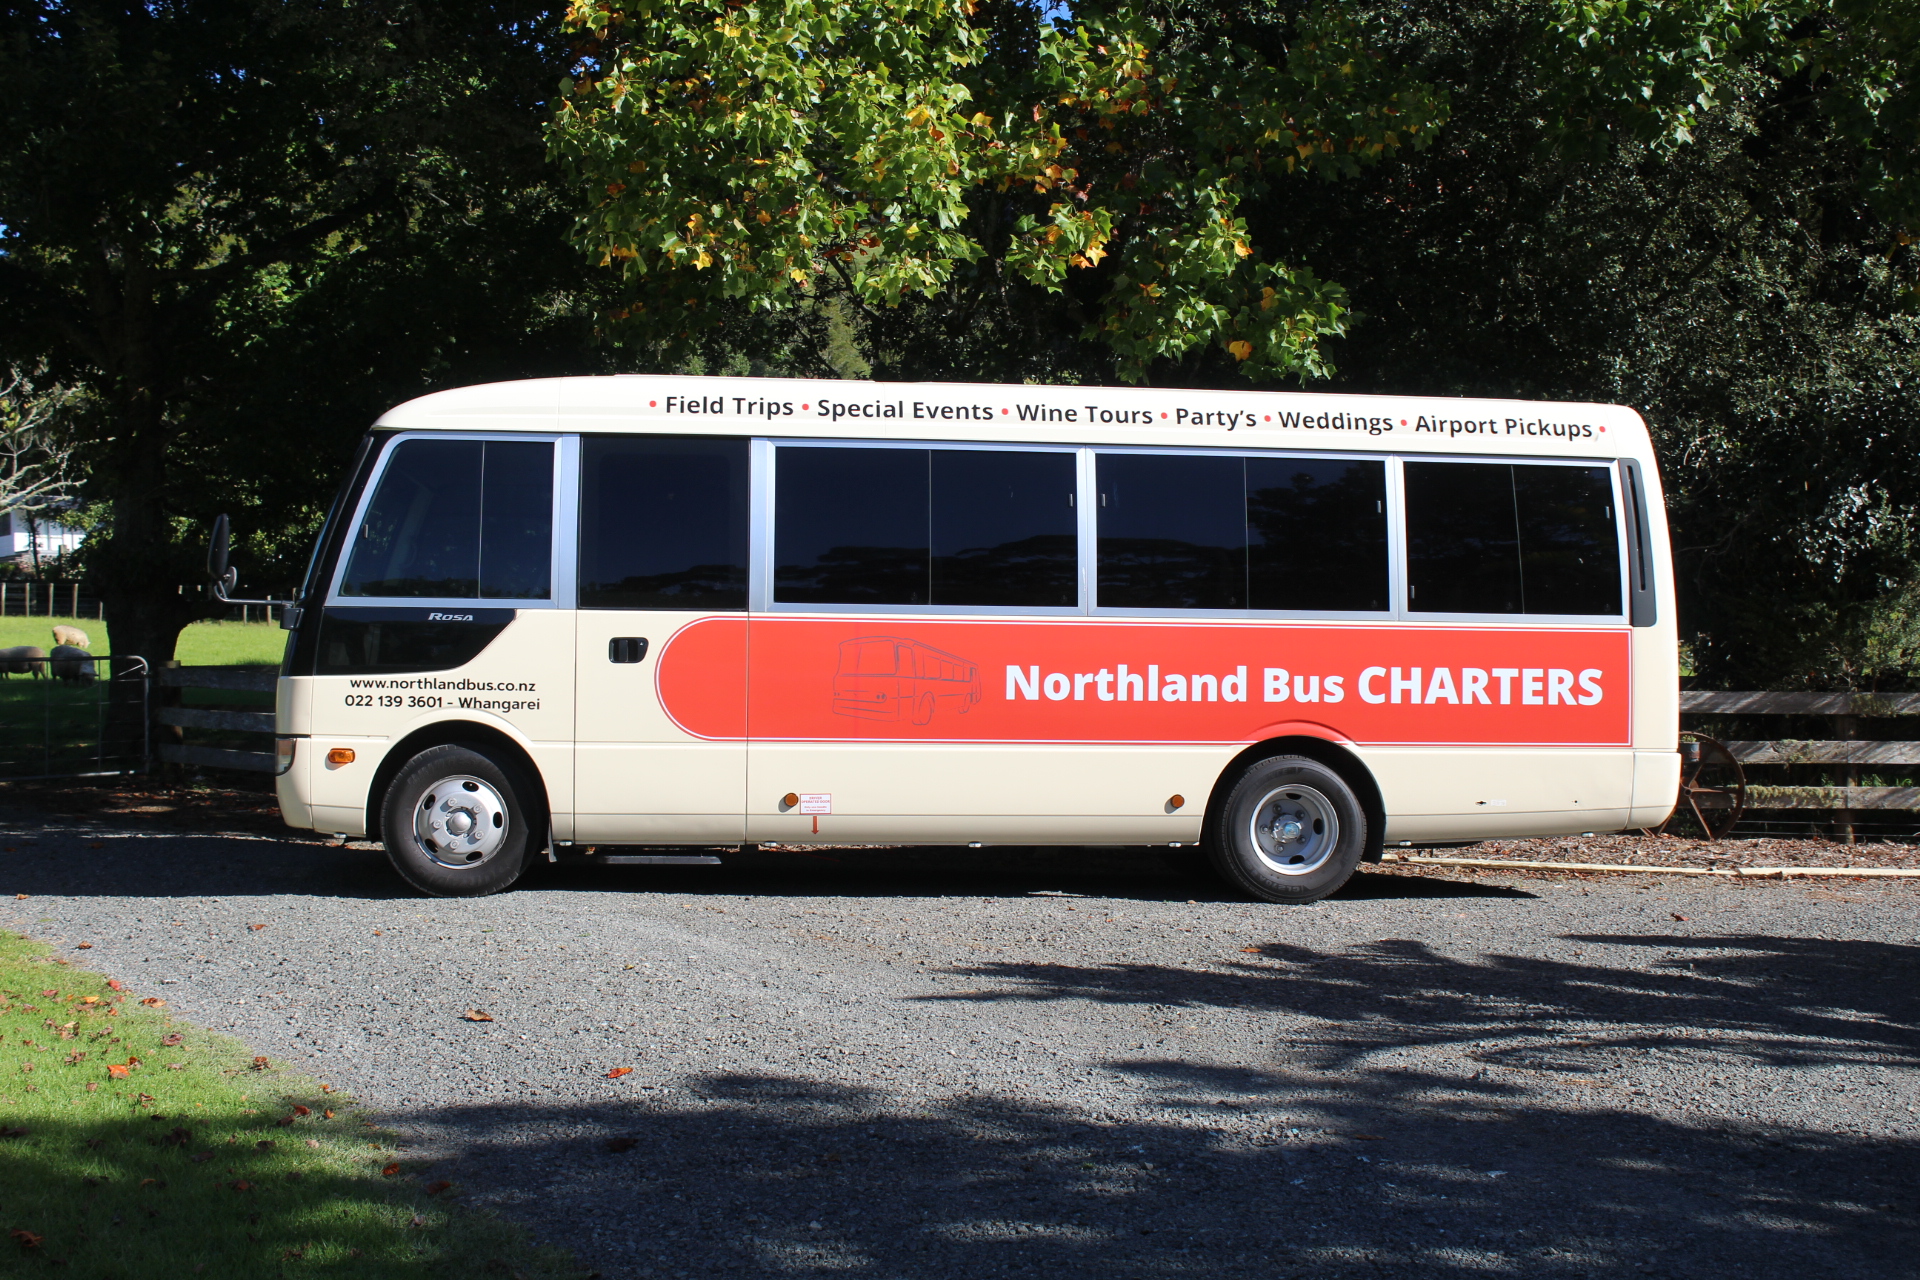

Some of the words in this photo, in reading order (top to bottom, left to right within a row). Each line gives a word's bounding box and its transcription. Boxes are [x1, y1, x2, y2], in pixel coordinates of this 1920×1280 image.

[666, 396, 724, 415] Field
[732, 397, 794, 421] Trips
[817, 399, 904, 422] Special
[913, 401, 994, 421] Events
[1015, 403, 1078, 423] Wine
[1084, 405, 1153, 425] Tours
[1176, 408, 1257, 432] Party's
[1278, 411, 1394, 436] Weddings
[1415, 415, 1498, 438] Airport
[1505, 418, 1593, 441] Pickups
[349, 677, 537, 692] www.northlandbus.co.nz
[1005, 663, 1248, 703] Northland
[1263, 667, 1345, 704] Bus
[1357, 666, 1604, 706] CHARTERS
[344, 694, 373, 707] 022
[377, 695, 403, 708] 139
[407, 696, 443, 708] 3601
[458, 697, 541, 714] Whangarei
